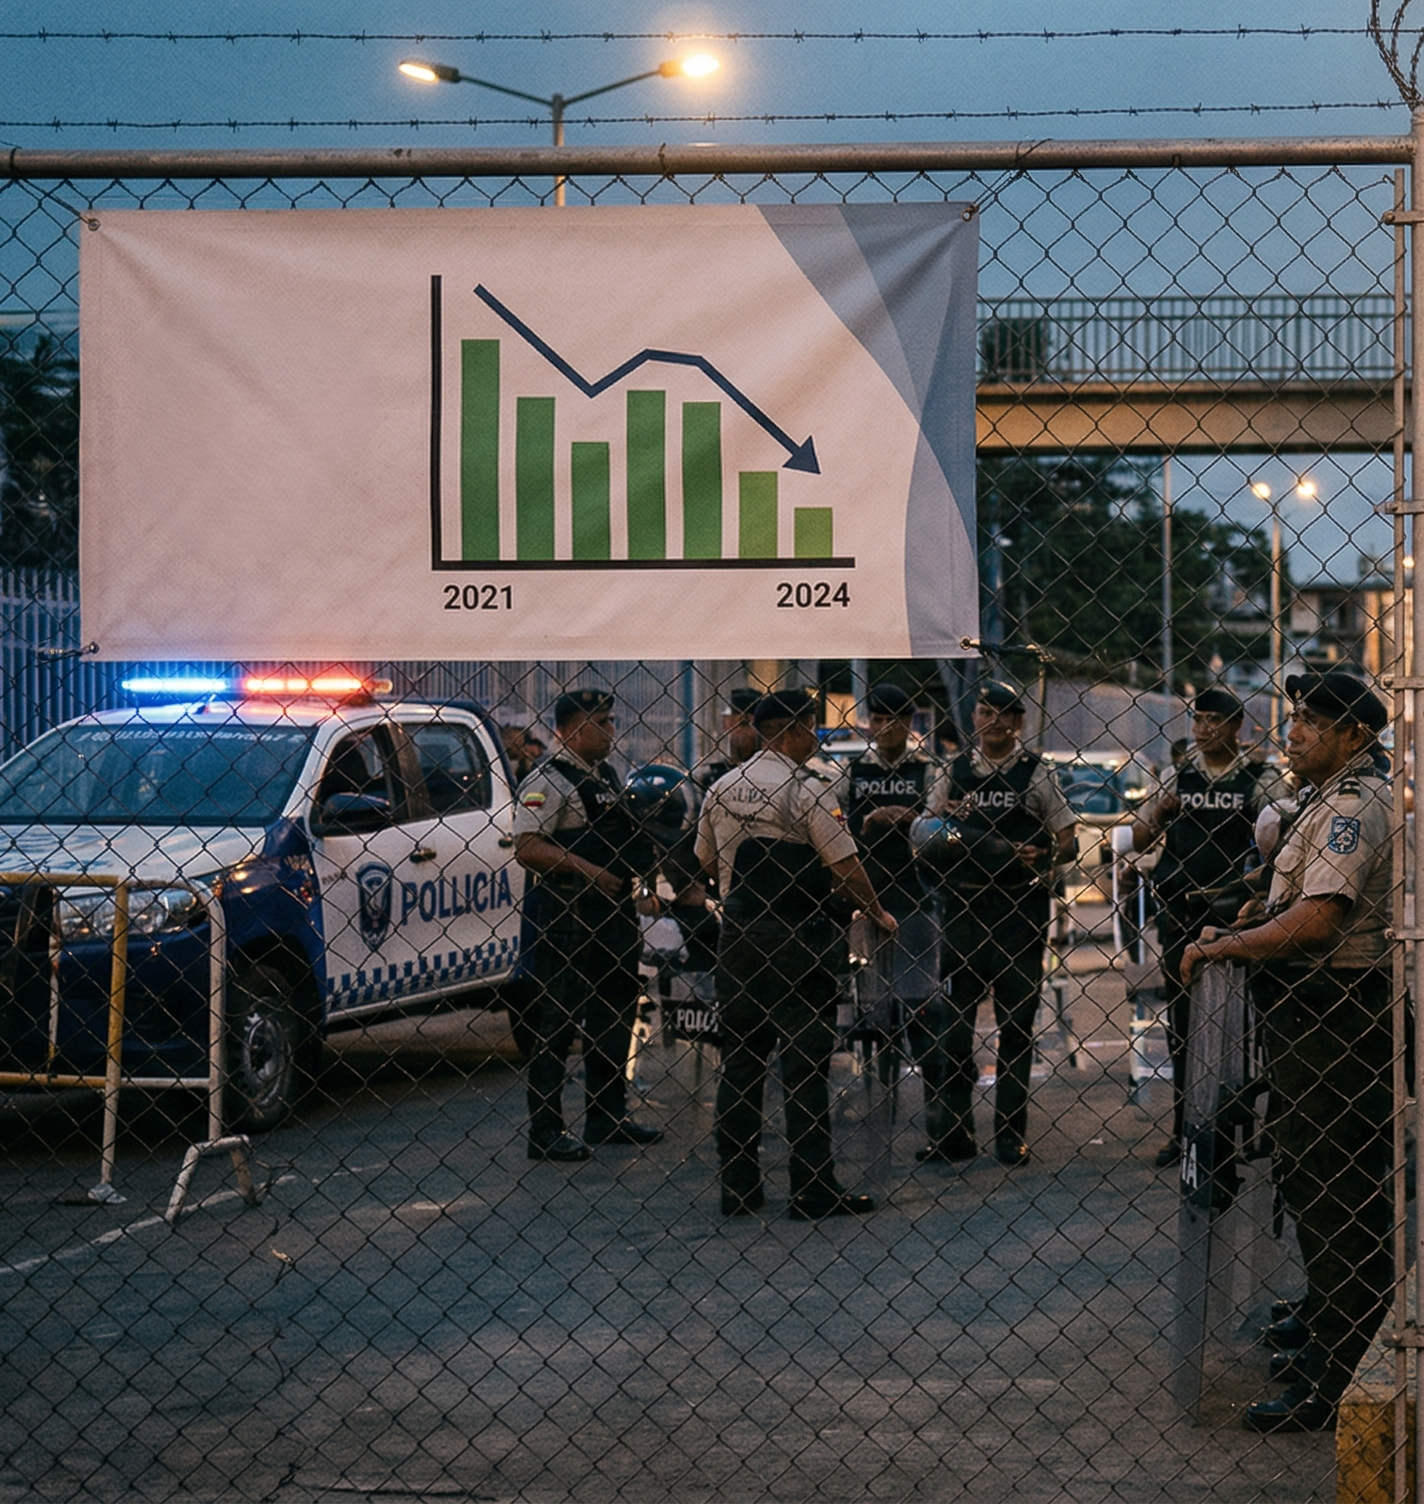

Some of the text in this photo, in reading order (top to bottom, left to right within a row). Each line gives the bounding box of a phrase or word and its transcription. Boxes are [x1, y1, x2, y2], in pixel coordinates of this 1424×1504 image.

[443, 581, 851, 610] 2021 2024
[858, 779, 917, 796] POLICE
[1180, 791, 1245, 810] POLICE
[401, 867, 513, 926] POLLICIA
